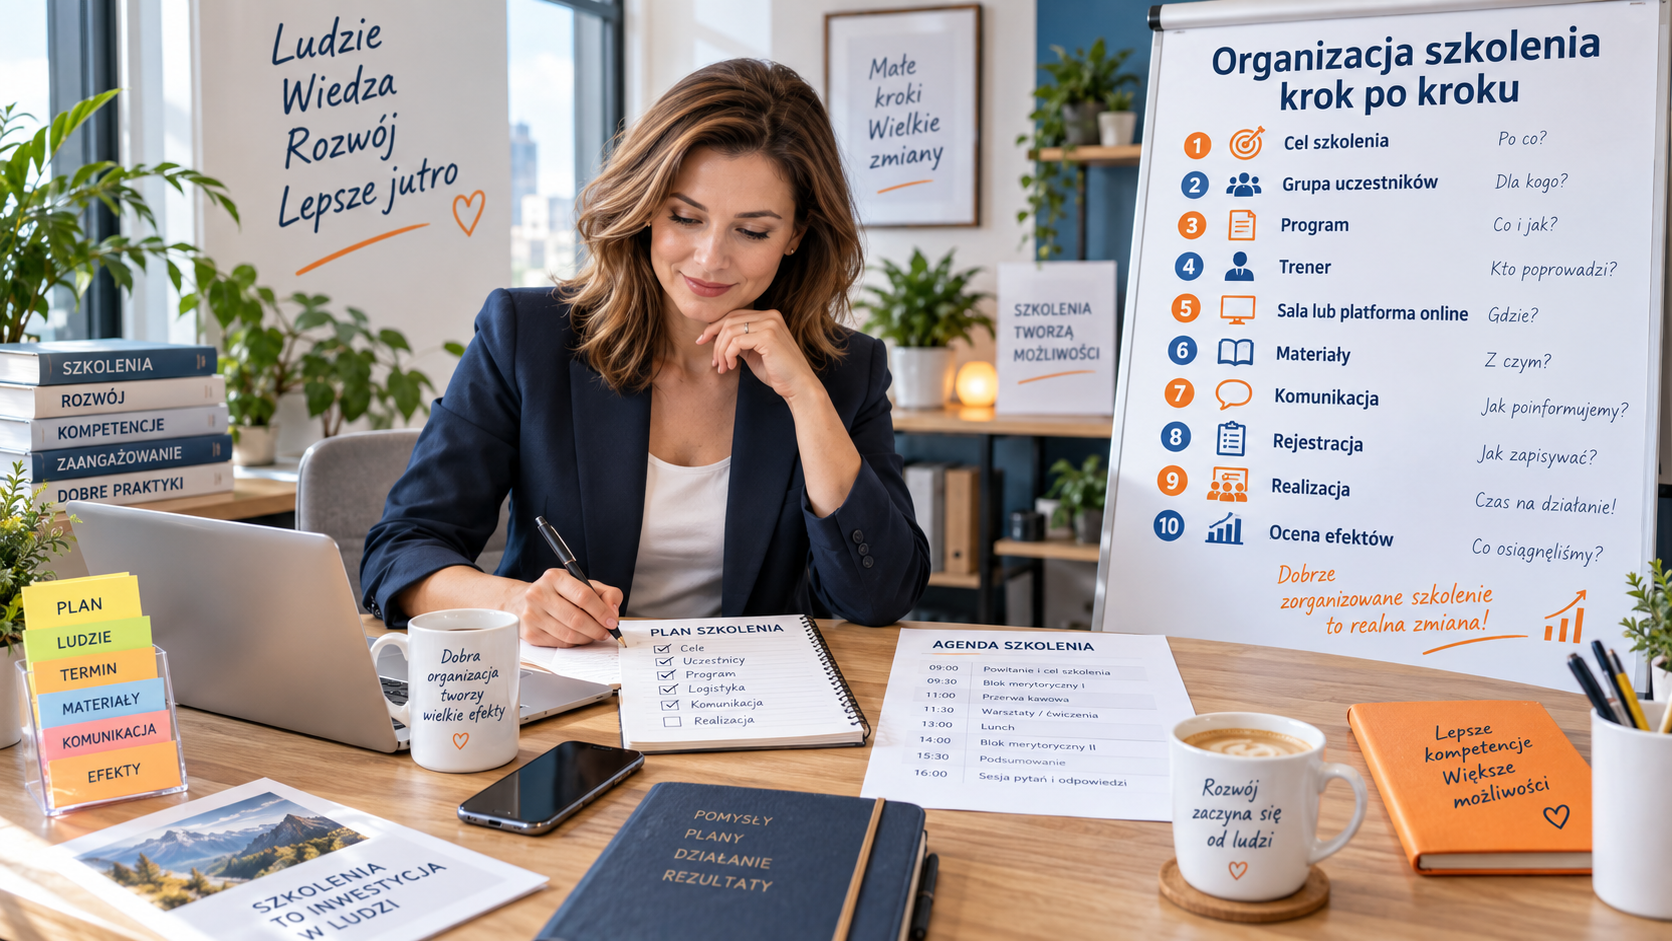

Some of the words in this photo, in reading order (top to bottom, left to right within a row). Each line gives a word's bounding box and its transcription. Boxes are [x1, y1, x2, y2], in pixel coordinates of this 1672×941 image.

[272, 16, 382, 65] Ludzie
[1213, 36, 1413, 81] Organizacja
[1425, 26, 1599, 65] szkolenia
[869, 53, 916, 80] Małe
[284, 64, 397, 115] Wiedza
[875, 82, 922, 108] kroki
[1281, 79, 1354, 110] krok
[1365, 85, 1406, 115] po
[1419, 73, 1518, 106] kroku
[869, 111, 940, 140] Wielkie
[285, 112, 397, 169] Rozwój
[1193, 138, 1201, 153] 1
[1285, 135, 1308, 150] Cel
[1314, 133, 1388, 149] szkolenia
[1499, 131, 1516, 146] Po
[1522, 130, 1547, 145] co?
[869, 146, 943, 171] zmiany
[1189, 177, 1200, 193] 2
[1283, 177, 1330, 194] Grupa
[1336, 174, 1438, 190] uczestników
[1495, 174, 1519, 189] Dla
[1526, 173, 1568, 193] kogo?
[279, 182, 377, 233] Lepsze
[380, 158, 458, 216] jutro
[1186, 218, 1197, 233] 3
[1282, 218, 1349, 235] Program
[1494, 217, 1511, 232] Co
[1523, 216, 1558, 236] jak?
[1183, 258, 1195, 274] 4
[1279, 260, 1331, 274] Trener
[1491, 261, 1516, 276] Kto
[1521, 261, 1617, 281] poprowadzi?
[1015, 302, 1092, 317] SZKOLENIA
[1180, 300, 1191, 317] 5
[1278, 303, 1308, 318] Sala
[1313, 303, 1336, 318] lub
[1341, 304, 1415, 322] platforma
[1420, 305, 1468, 321] online
[1489, 306, 1538, 323] Gdzie?
[1015, 325, 1074, 340] TWORZĄ
[1014, 344, 1100, 361] MOŻLIWOŚCI
[1177, 342, 1188, 358] 6
[1277, 346, 1351, 366] Materiały
[1485, 352, 1497, 367] Z
[1504, 354, 1552, 373] czym?
[63, 358, 153, 375] SZKOLENIA
[62, 388, 124, 408] ROZWÓJ
[1174, 385, 1186, 401] 7
[1275, 388, 1378, 410] Komunikacja
[1481, 397, 1505, 416] Jak
[1511, 398, 1629, 423] poinformujemy?
[58, 418, 164, 440] KOMPETENCJE
[57, 446, 182, 471] ZAANGAŻOWANIE
[1170, 428, 1182, 445] 8
[1274, 433, 1363, 453] Rejestracja
[1477, 444, 1503, 463] Jak
[1510, 449, 1597, 469] zapisywać?
[58, 485, 108, 504] DOBRE
[114, 477, 183, 497] PRAKTYKI
[1167, 472, 1178, 490] 9
[1272, 478, 1350, 500] Realizacja
[1476, 492, 1509, 509] Czas
[1517, 499, 1535, 510] na
[1542, 495, 1616, 514] działanie!
[1160, 517, 1179, 534] 10
[1270, 525, 1320, 542] Ocena
[1325, 528, 1394, 547] efektów
[1472, 538, 1490, 554] Co
[1497, 542, 1603, 567] osiągnęliśmy?
[1278, 563, 1335, 584] Dobrze
[57, 597, 102, 615] PLAN
[1280, 591, 1403, 615] zorganizowane
[1412, 585, 1492, 605] szkolenie
[651, 628, 691, 637] PLAN
[697, 624, 784, 635] SZKOLENIA
[1326, 617, 1343, 634] to
[1350, 613, 1406, 633] realna
[1413, 609, 1489, 632] zmiana!
[57, 631, 111, 649] LUDZIE
[681, 644, 704, 652] Cele
[933, 640, 999, 649] AGENDA
[1005, 641, 1094, 651] SZKOLENIA
[441, 648, 480, 664] Dobra
[684, 656, 745, 666] Uczestnicy
[60, 662, 116, 681] TERMIN
[427, 669, 499, 687] organizacja
[686, 671, 736, 681] Program
[689, 683, 745, 696] Logistyka
[1009, 682, 1078, 690] merytoryczny
[63, 692, 139, 715] MATERIAŁY
[441, 689, 484, 705] tworzy
[691, 699, 763, 710] Komunikacja
[424, 708, 463, 721] wielkie
[469, 704, 505, 723] efekty
[695, 715, 755, 727] Realizacja
[982, 708, 1035, 718] Warsztaty
[62, 723, 156, 749] KOMUNIKACJA
[920, 736, 951, 744] 14:00
[1009, 742, 1085, 752] merytoryczny
[1436, 725, 1492, 742] Lepsze
[918, 752, 949, 760] 15:30
[980, 755, 1065, 766] Podsumowanie
[1425, 738, 1533, 763] kompetencje
[88, 763, 140, 783] EFEKTY
[915, 769, 947, 777] 16:00
[979, 773, 1010, 782] Sesja
[1014, 773, 1047, 783] pytań
[1059, 777, 1127, 786] odpowiedzi
[1443, 763, 1515, 786] Większe
[1203, 778, 1259, 803] Rozwój
[1454, 776, 1550, 809] możliwości
[694, 810, 773, 826] POMYSŁY
[1193, 807, 1252, 827] zaczyna
[1260, 805, 1281, 824] się
[685, 829, 744, 843] PLANY
[1207, 830, 1225, 848] od
[1233, 830, 1274, 849] ludzi
[674, 848, 772, 869] DZIAŁANIE
[252, 863, 387, 913] SZKOLENIA
[662, 869, 772, 892] REZULTATY
[270, 912, 305, 927] TO
[306, 863, 447, 915] INWESTYCJA
[298, 926, 324, 940] W
[327, 899, 400, 930] LUDZI
